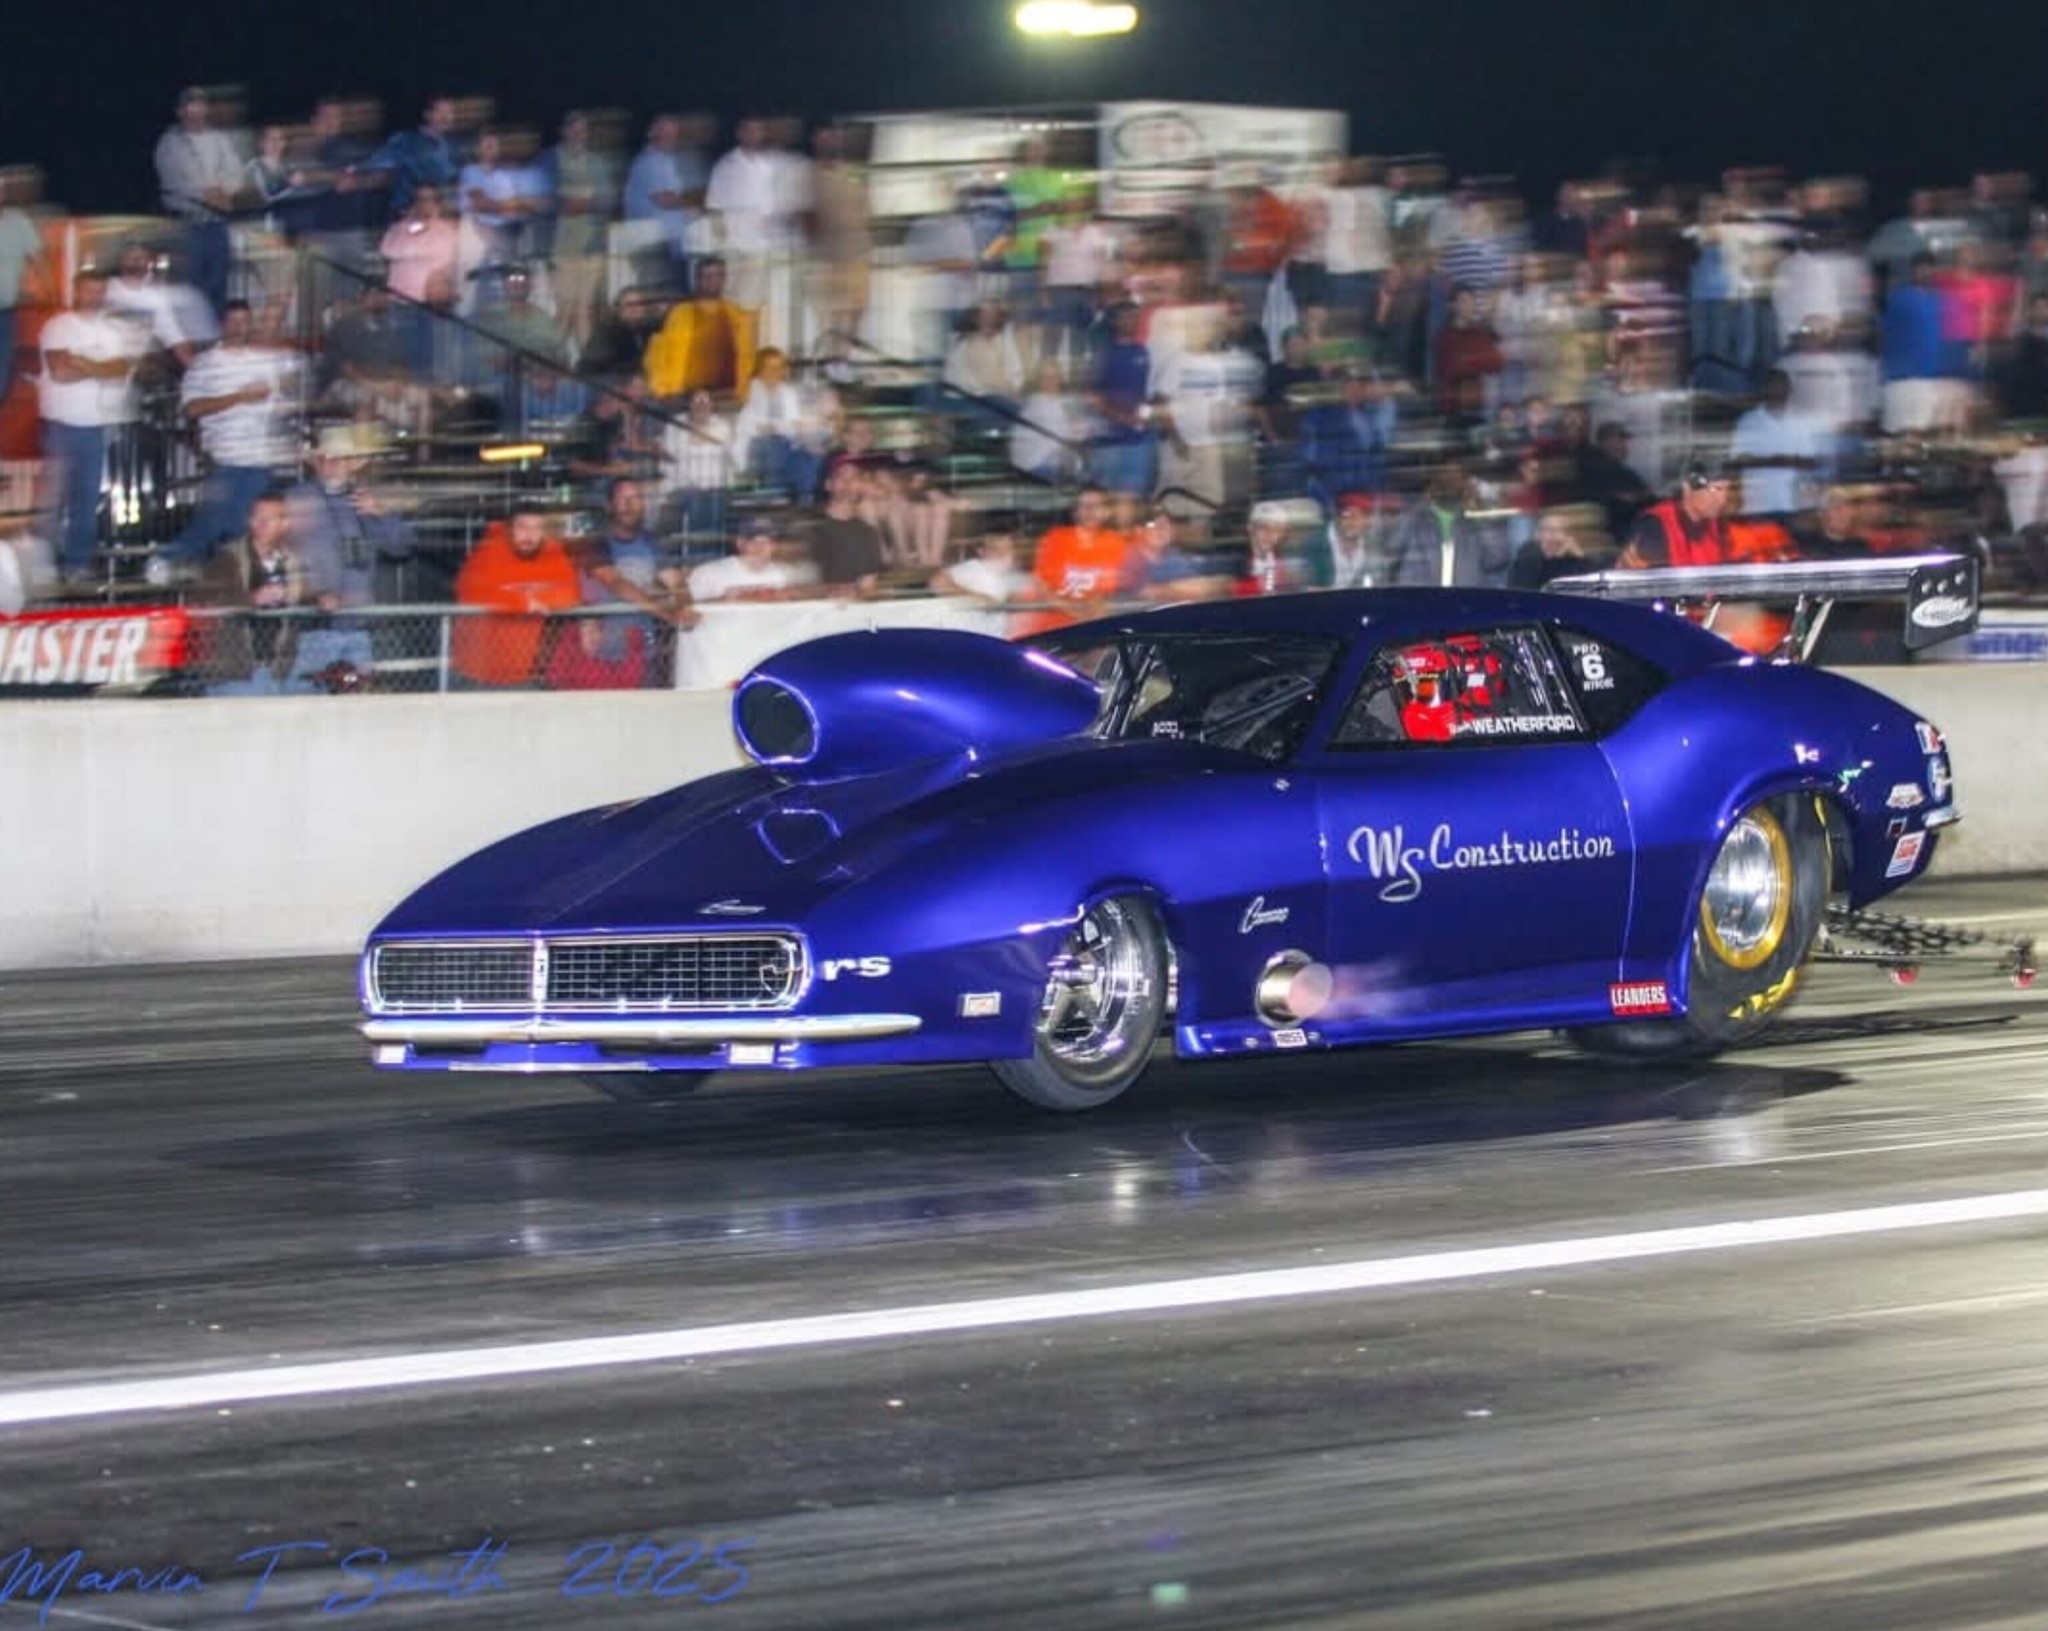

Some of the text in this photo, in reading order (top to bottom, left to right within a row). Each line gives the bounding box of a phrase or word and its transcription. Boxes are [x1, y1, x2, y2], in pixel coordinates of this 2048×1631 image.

[1572, 643, 1600, 655] PRO
[1581, 654, 1605, 680] 6
[1472, 715, 1575, 733] WEATHERFORD
[1430, 824, 1615, 869] Construction
[1611, 986, 1667, 1007] LEANDERS
